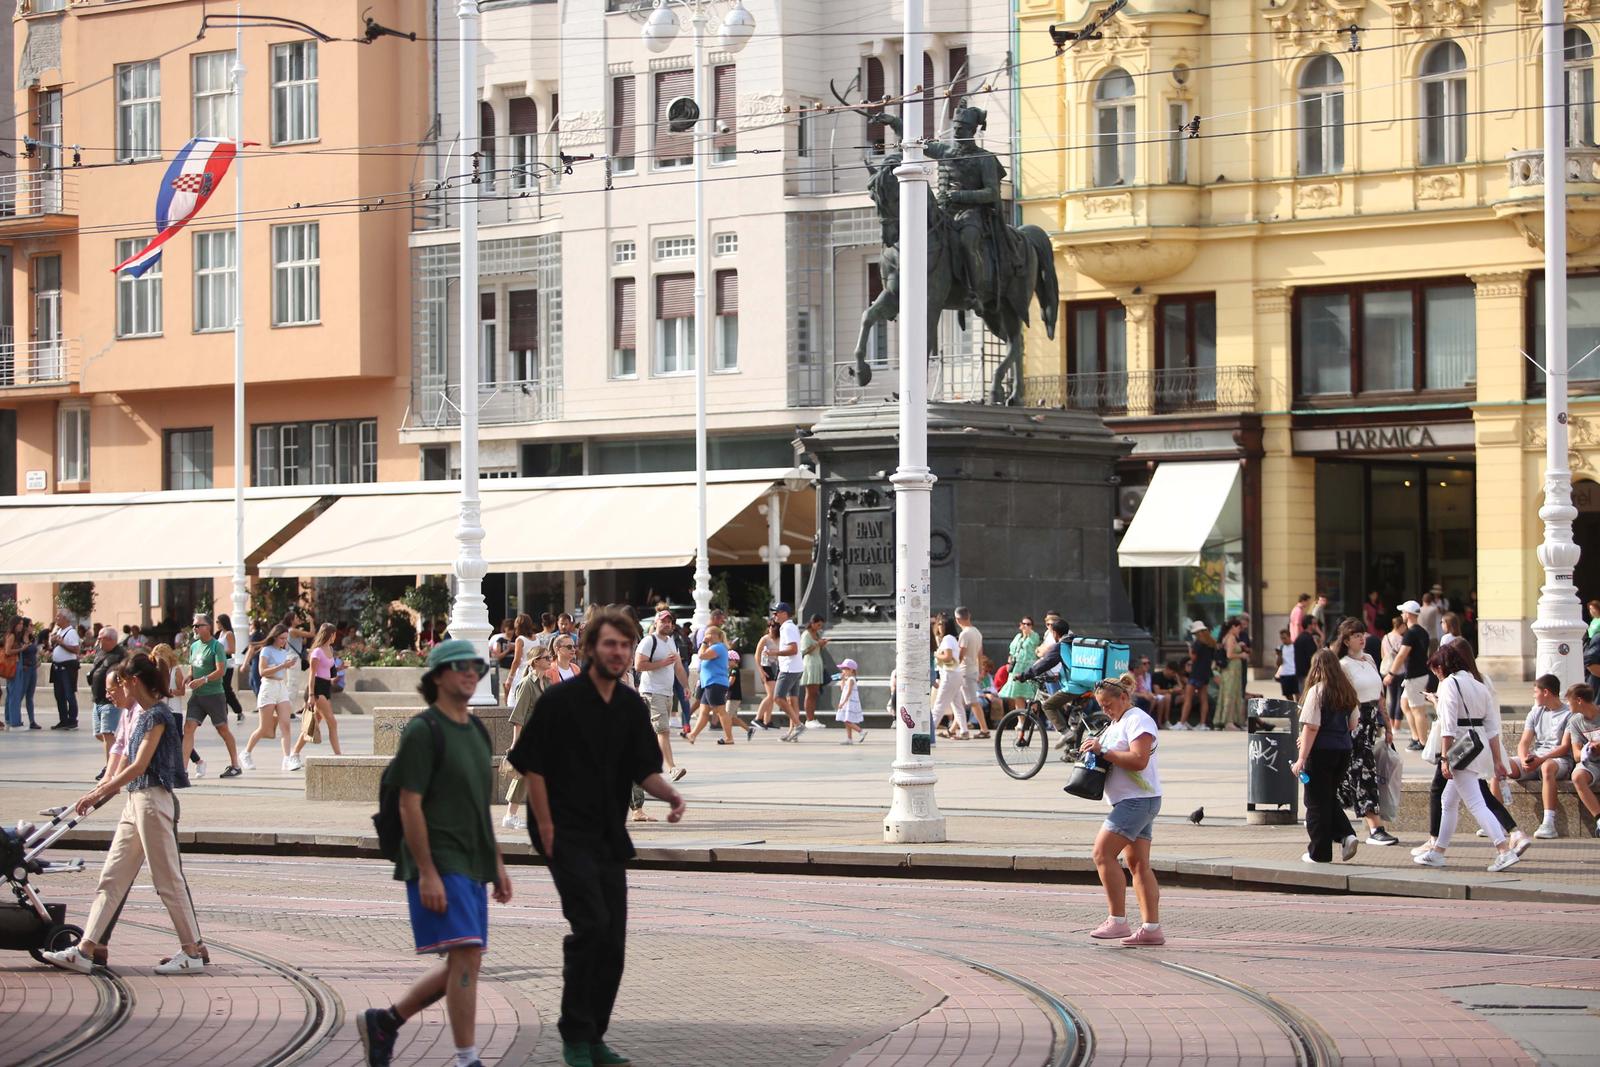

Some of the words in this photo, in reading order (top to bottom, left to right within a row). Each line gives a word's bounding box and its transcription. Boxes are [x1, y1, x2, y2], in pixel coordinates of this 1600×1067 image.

[1163, 432, 1204, 450] Mala
[1336, 426, 1437, 449] HARMICA
[856, 520, 883, 539] BAN
